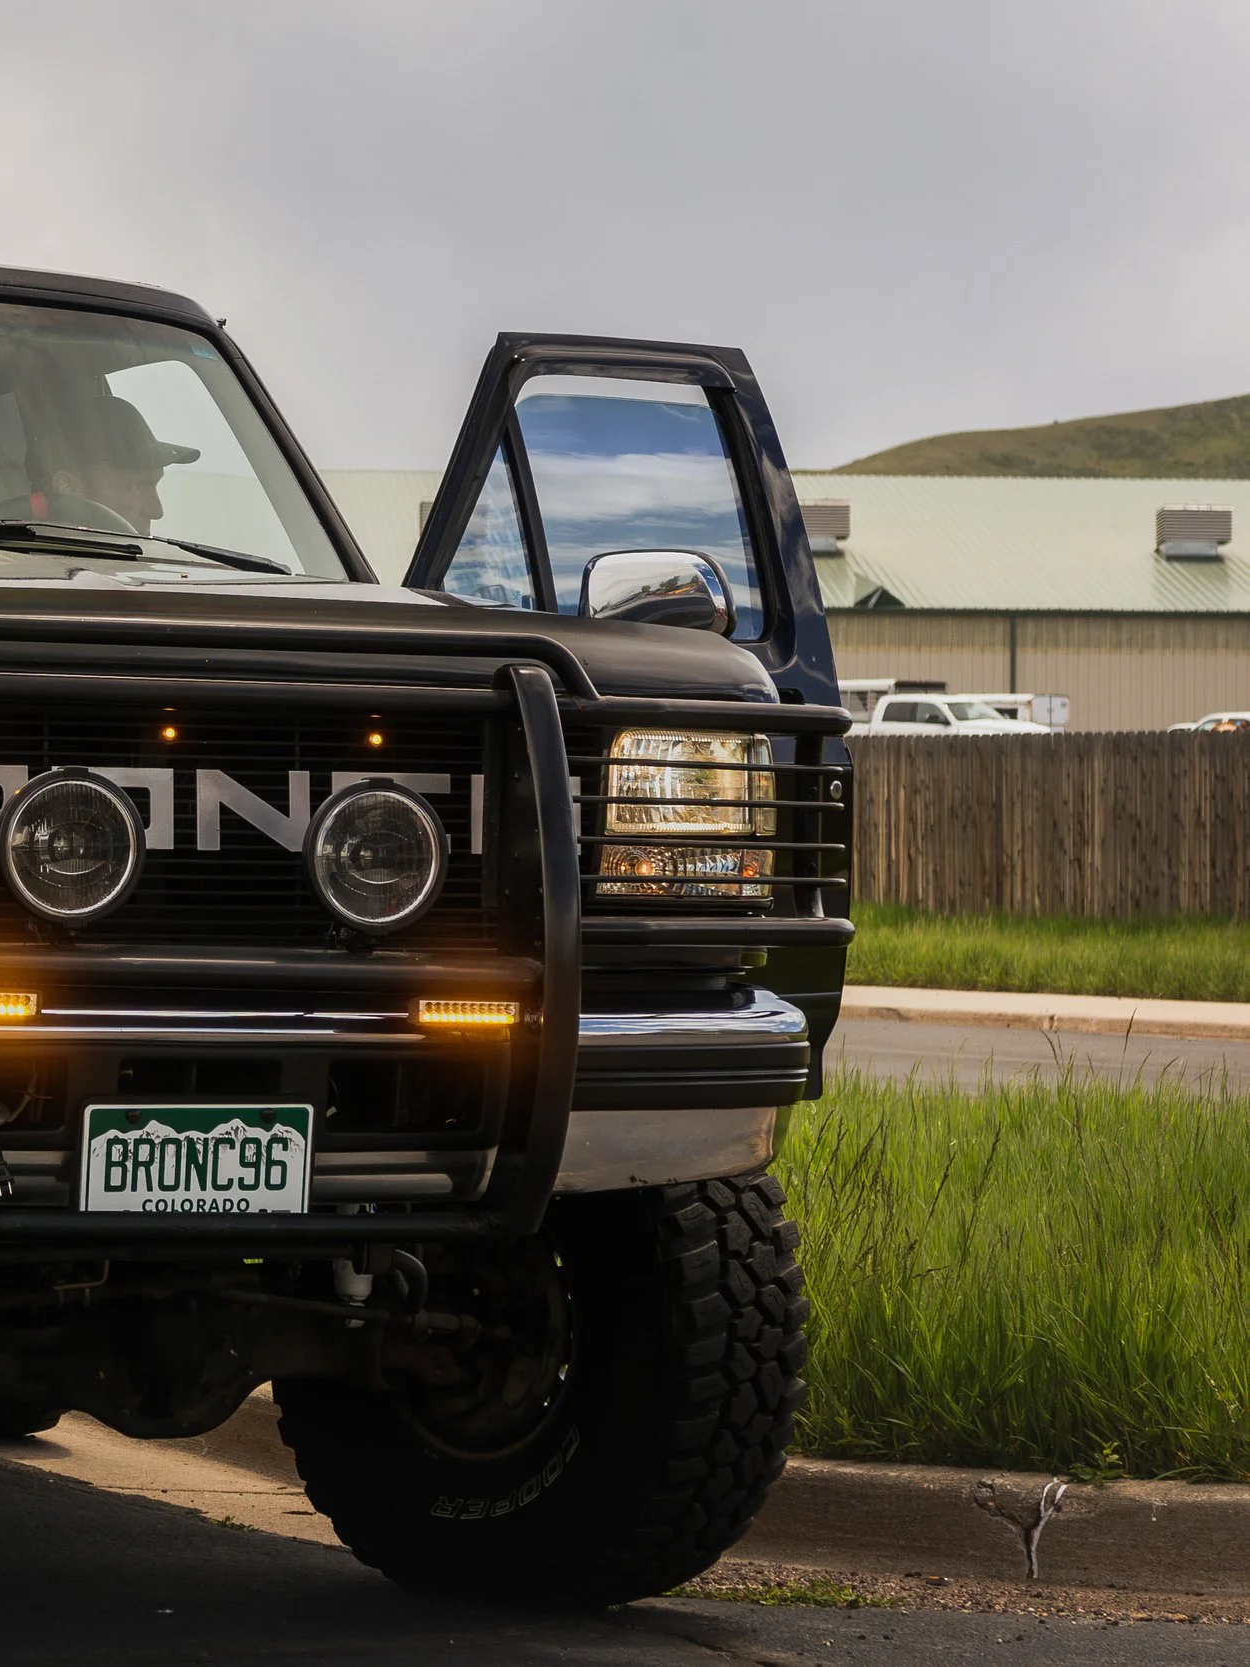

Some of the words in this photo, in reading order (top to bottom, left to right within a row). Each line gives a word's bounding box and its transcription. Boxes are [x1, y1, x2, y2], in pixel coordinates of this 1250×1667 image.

[104, 1137, 288, 1192] BRONC96
[142, 1197, 250, 1213] COLORADO
[430, 1424, 581, 1519] COOPER
